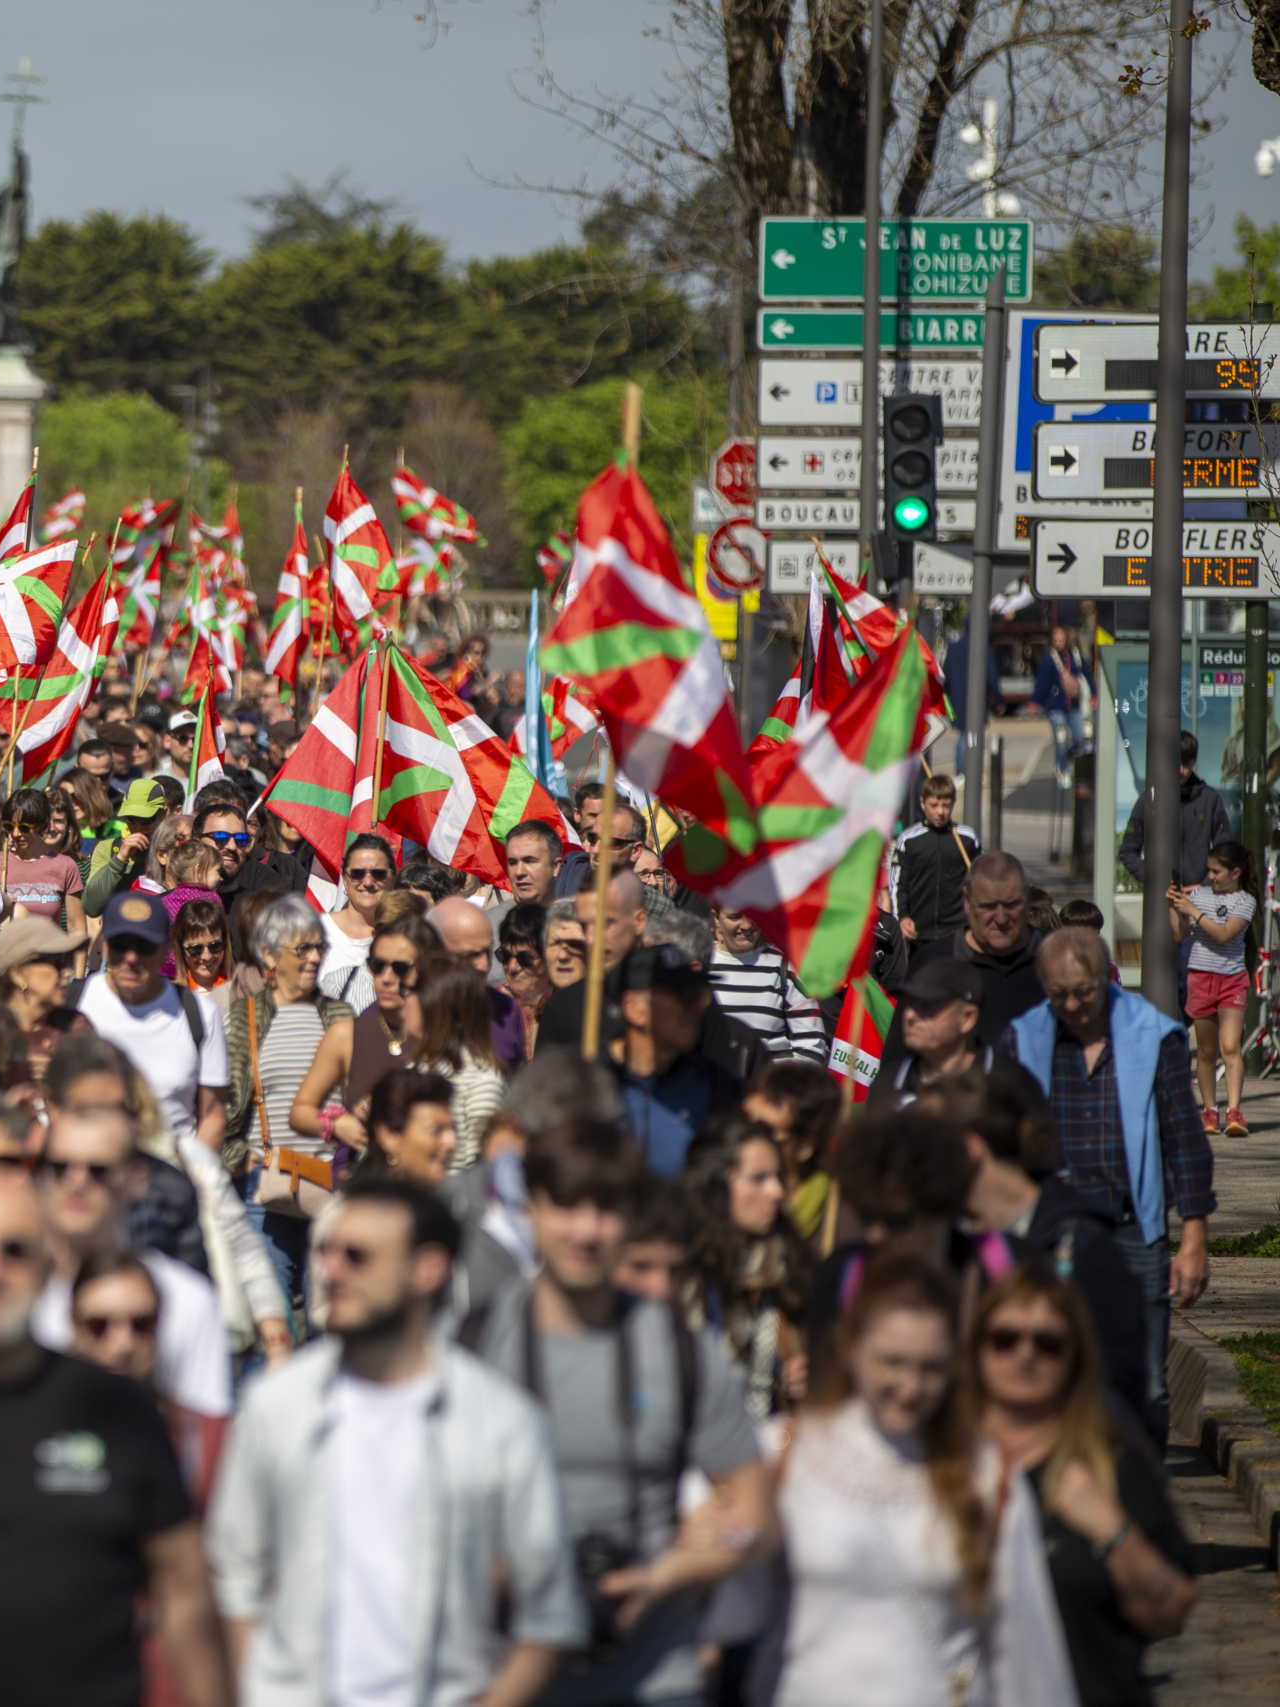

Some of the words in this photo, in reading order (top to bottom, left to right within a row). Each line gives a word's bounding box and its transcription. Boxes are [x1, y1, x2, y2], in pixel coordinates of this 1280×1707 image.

[939, 233, 962, 251] DE
[975, 227, 1022, 251] LUZ
[898, 252, 1022, 273] DONIBANE
[900, 273, 1022, 294] LOHIZUE
[1216, 359, 1259, 388] 95
[1131, 429, 1251, 452] BFORT
[764, 505, 855, 523] BOUCAU
[1114, 528, 1266, 551] BOFLERS
[1126, 557, 1253, 586] ETRE
